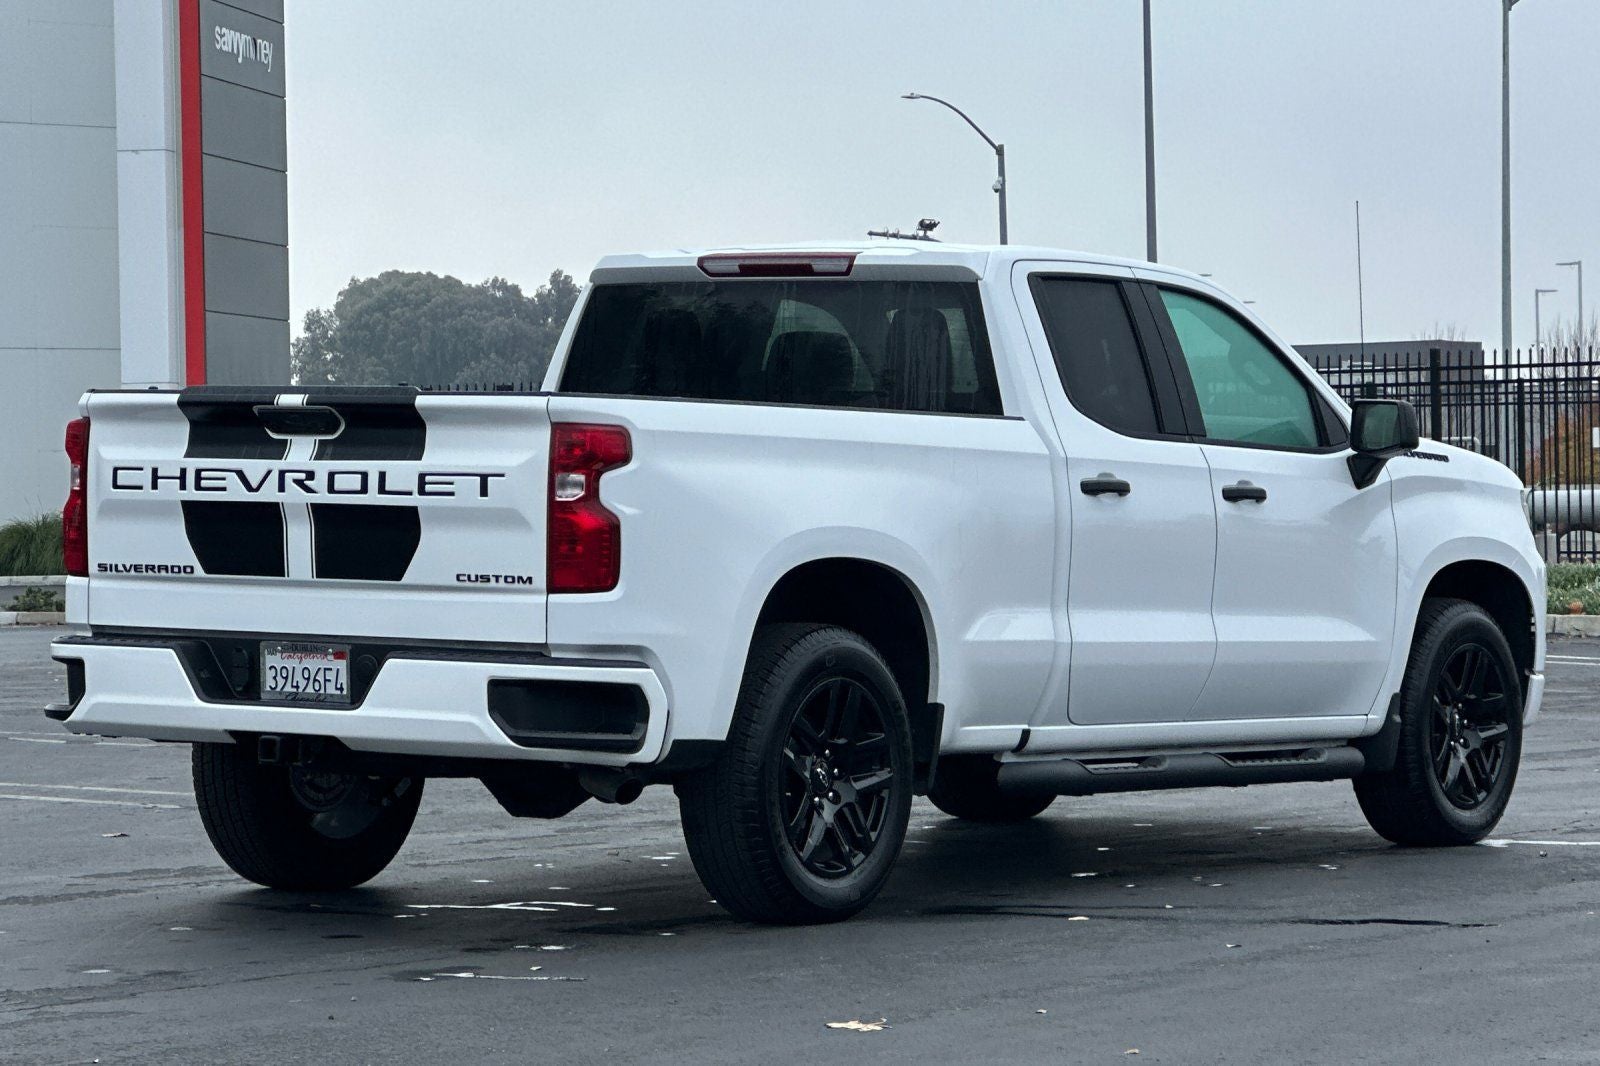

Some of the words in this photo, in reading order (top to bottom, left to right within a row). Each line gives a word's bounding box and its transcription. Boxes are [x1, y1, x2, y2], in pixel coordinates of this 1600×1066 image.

[112, 466, 505, 497] CHEVROLET
[97, 563, 195, 575] SILVERADO
[455, 573, 533, 585] CUSTOM
[268, 665, 344, 694] 39496F4
